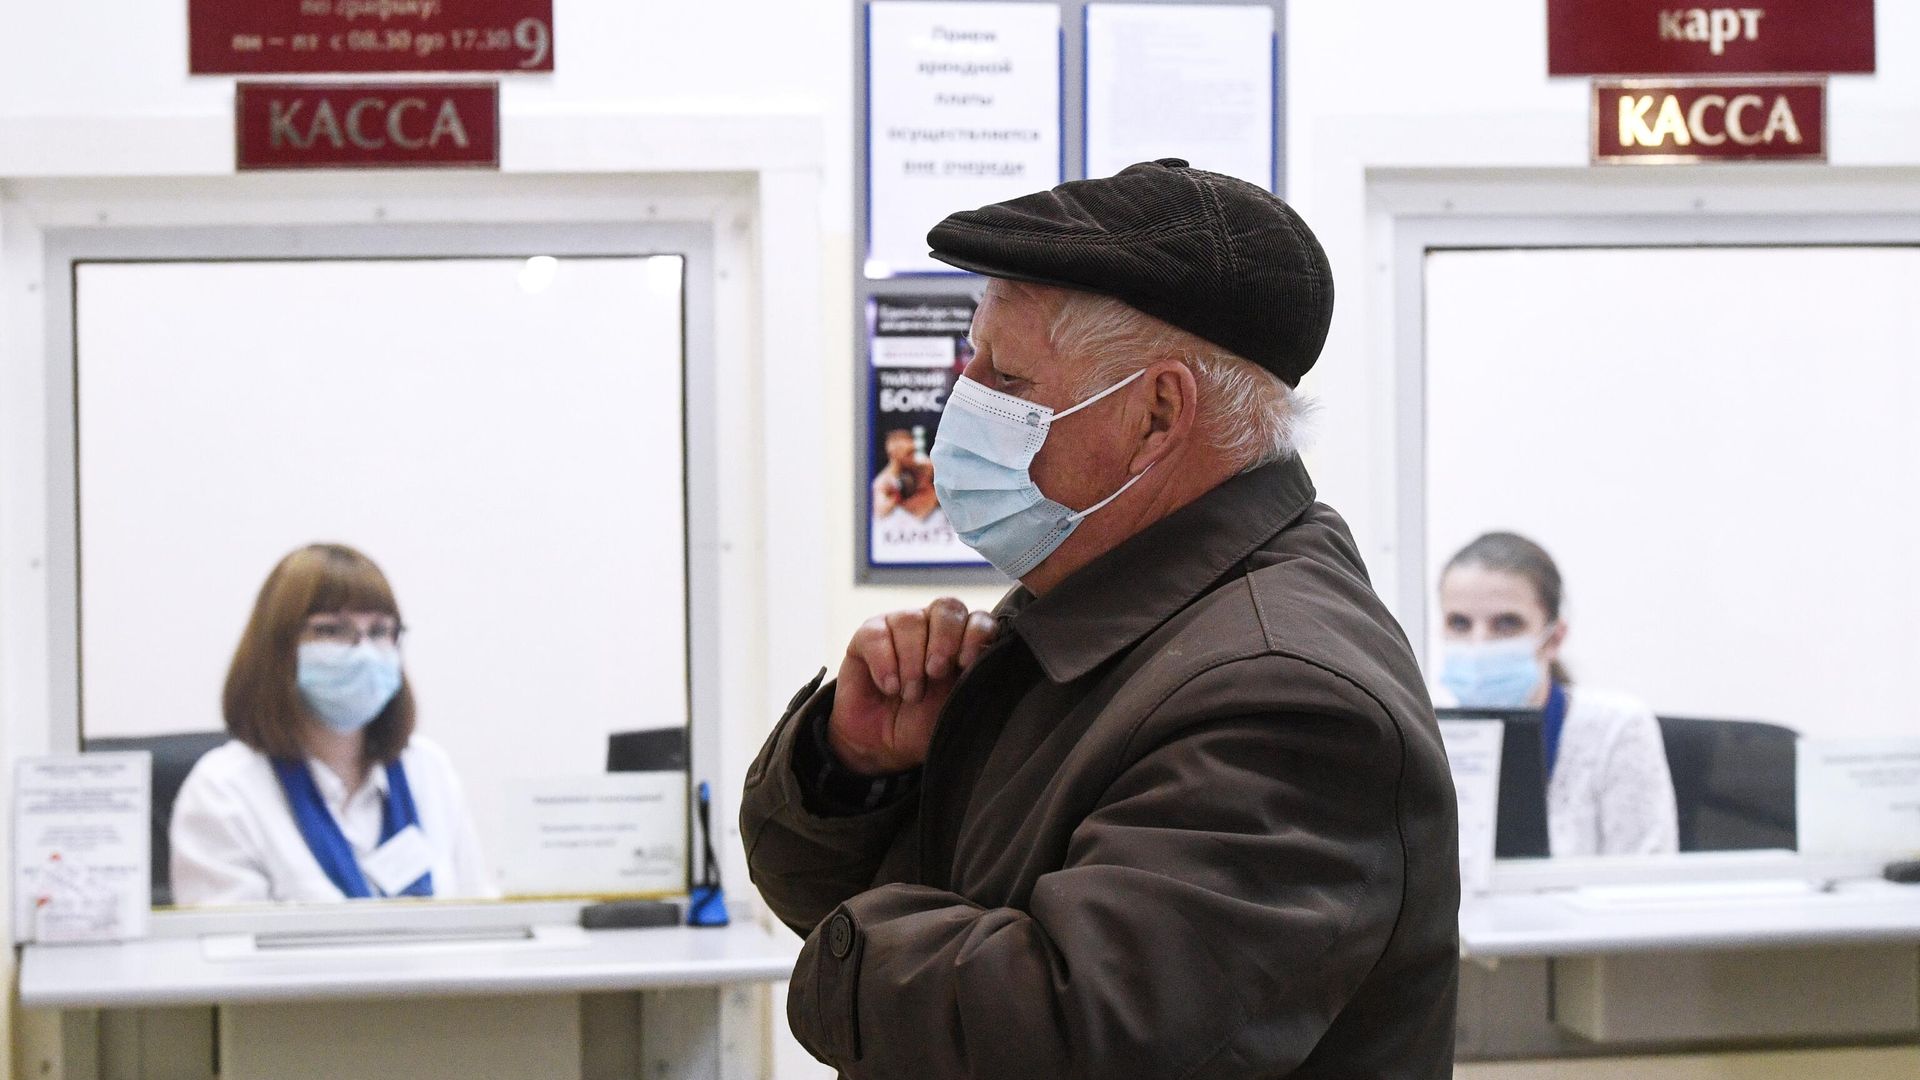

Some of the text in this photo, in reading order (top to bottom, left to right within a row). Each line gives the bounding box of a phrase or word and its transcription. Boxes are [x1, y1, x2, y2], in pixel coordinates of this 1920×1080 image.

[451, 28, 511, 51] 17.30
[514, 17, 549, 68] 9
[1658, 8, 1764, 55] карт
[268, 98, 469, 148] КАССА
[1618, 95, 1802, 147] КАССА
[880, 388, 945, 413] БОКС
